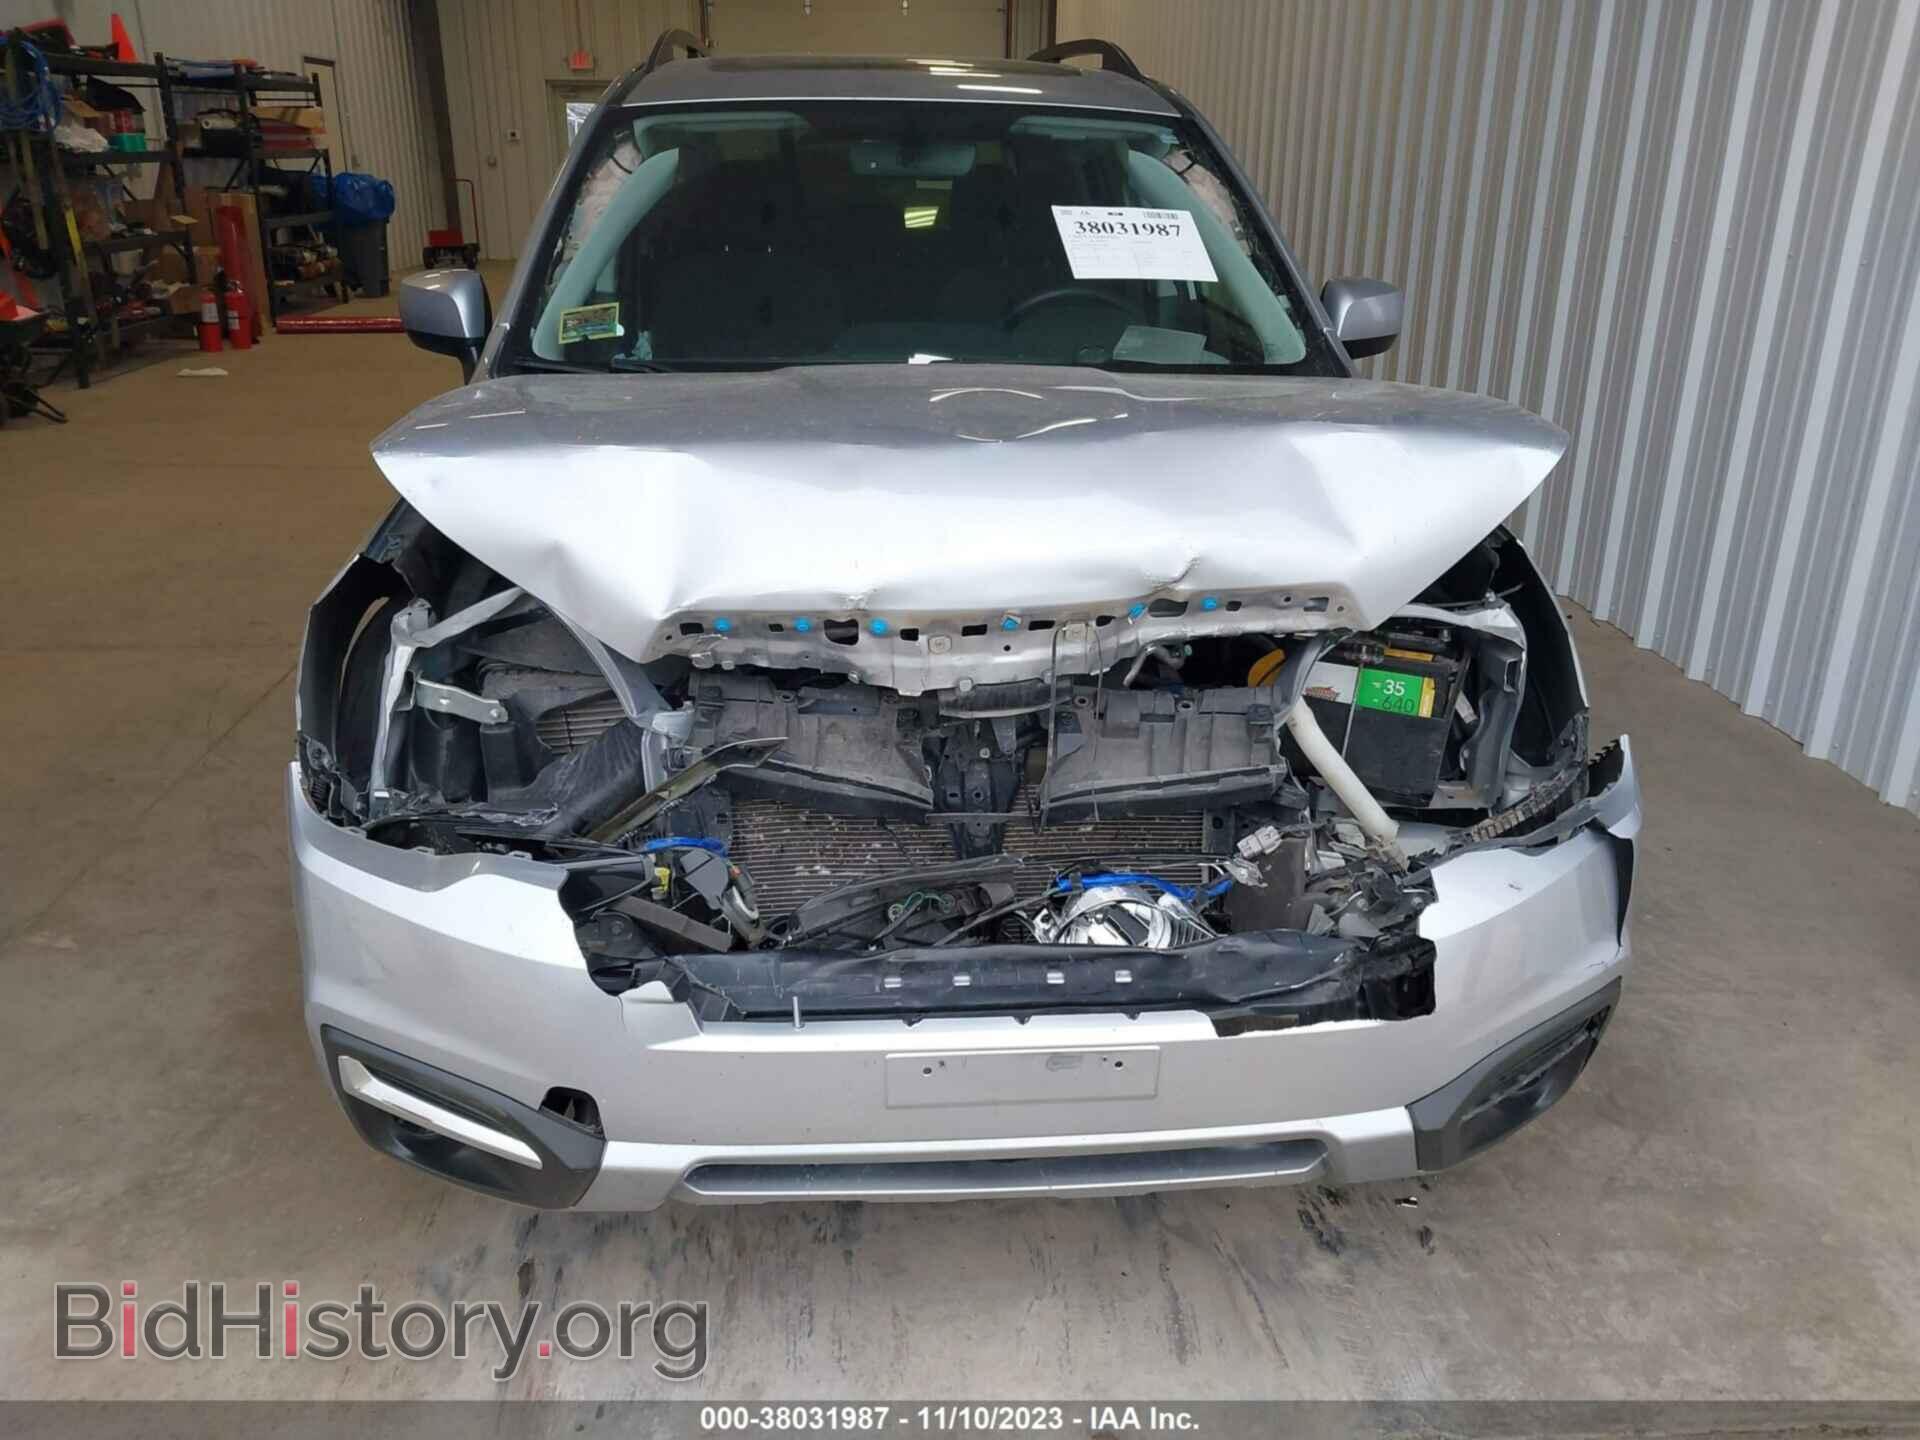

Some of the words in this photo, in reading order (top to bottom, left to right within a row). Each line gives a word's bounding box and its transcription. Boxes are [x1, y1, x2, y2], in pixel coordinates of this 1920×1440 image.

[1073, 220, 1181, 238] 38031987
[1383, 679, 1406, 696] 35
[1382, 696, 1415, 713] 640
